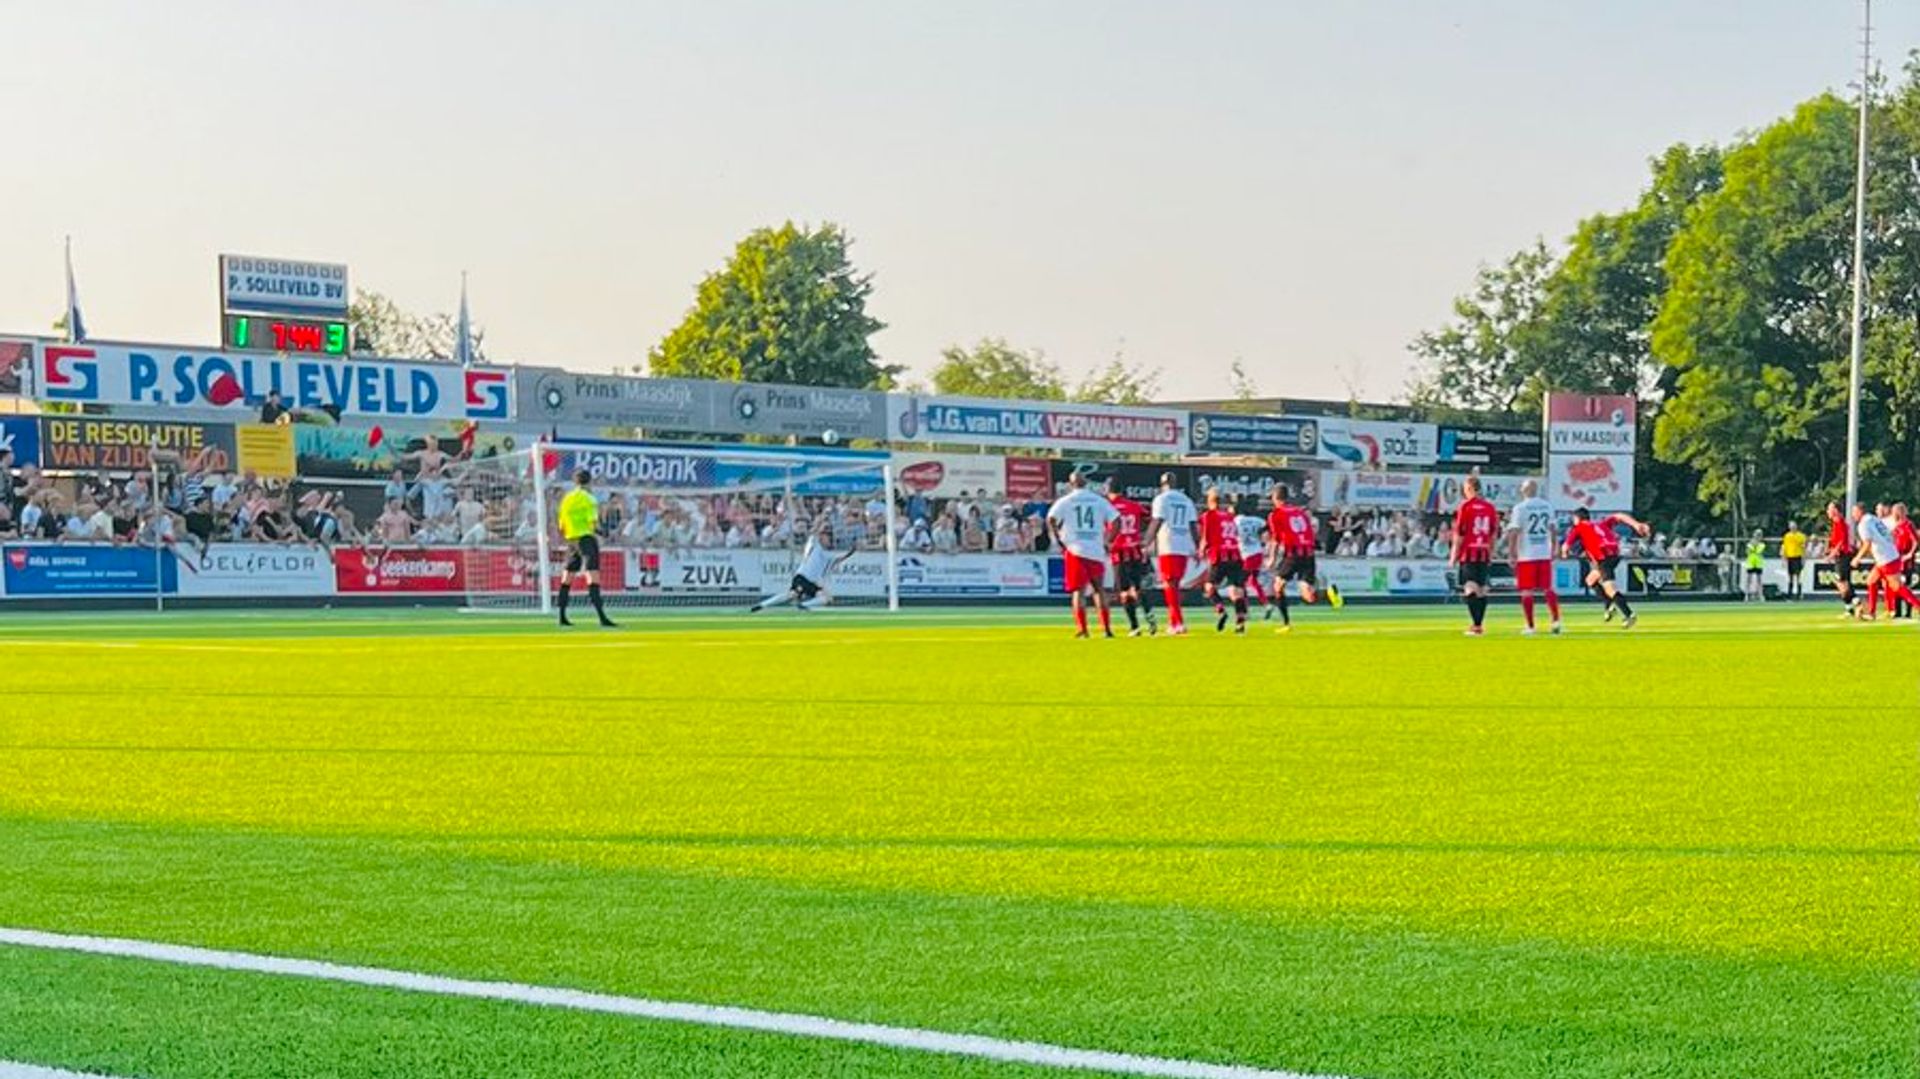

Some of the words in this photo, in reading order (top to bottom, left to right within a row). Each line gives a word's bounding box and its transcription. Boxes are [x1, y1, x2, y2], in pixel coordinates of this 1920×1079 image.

[229, 275, 241, 292] P.
[247, 277, 319, 296] SOLLEVELD
[325, 323, 346, 353] 3
[575, 378, 618, 399] Prins
[624, 382, 692, 410] Maasdijk
[766, 390, 806, 409] Prins
[811, 392, 872, 418] Maasdijk
[51, 420, 80, 443] DE
[86, 421, 204, 447] RESOLUTIE
[930, 407, 964, 430] J.G.
[966, 416, 999, 433] van
[1001, 412, 1045, 436] DIJK
[1048, 415, 1174, 441] VERWARMING
[1553, 429, 1569, 444] VV
[1571, 430, 1632, 448] MAASDIJK
[51, 445, 95, 466] VAN
[573, 451, 698, 482] Rabobank
[1075, 504, 1095, 530] 14
[1528, 513, 1549, 536] 23
[682, 565, 738, 585] ZUVA
